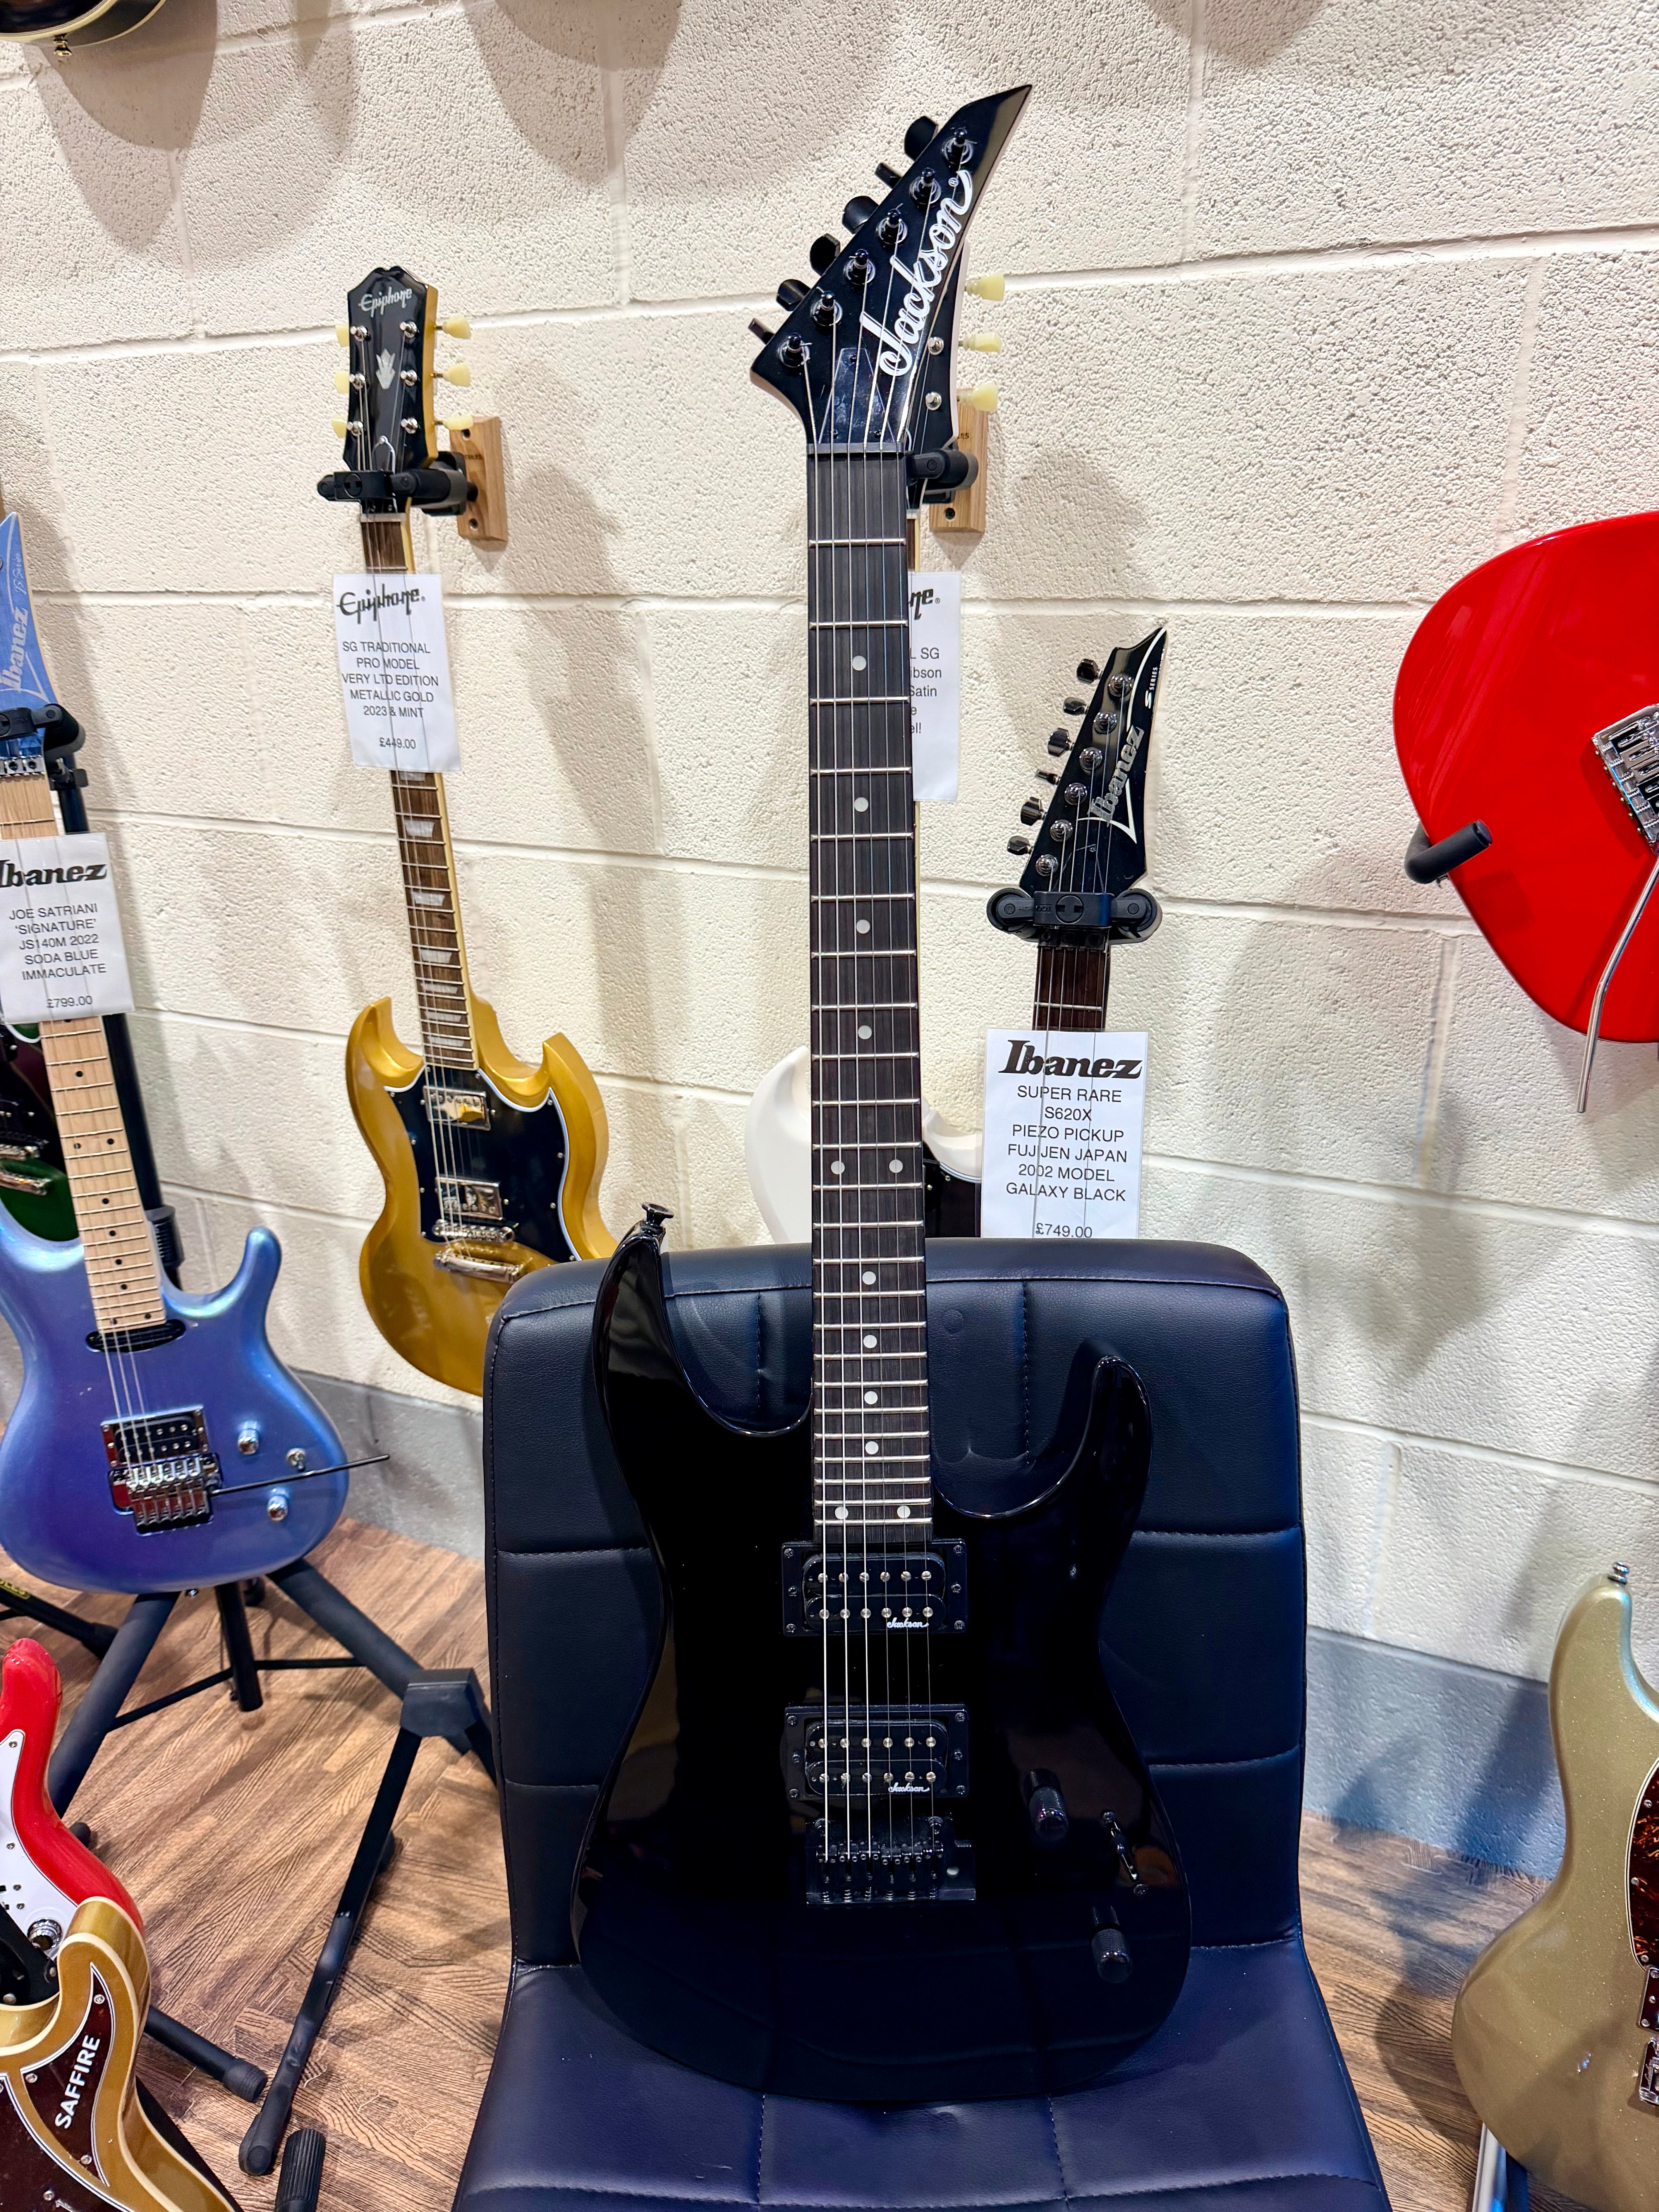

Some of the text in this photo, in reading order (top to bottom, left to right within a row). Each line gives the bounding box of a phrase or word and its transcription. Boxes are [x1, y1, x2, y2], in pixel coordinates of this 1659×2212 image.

[859, 169, 974, 377] Jackson
[359, 287, 412, 317] Epiphone
[337, 584, 420, 624] Epiphone
[0, 606, 28, 693] Ibanez
[343, 641, 431, 654] SG TRADITIONAL
[920, 647, 940, 659] SG
[357, 658, 419, 670] PRO MODEL
[910, 666, 941, 678] ibson
[342, 674, 439, 686] VERY LTD EDITION
[1149, 667, 1158, 690] SERIES
[350, 690, 434, 702] METALLIC GOLD
[364, 707, 424, 718] 2023 & MINT
[380, 738, 416, 749] £449.00
[1087, 725, 1145, 828] Ibanez
[0, 859, 107, 888] Ibanez
[9, 903, 98, 921] JOE SATRIANI
[20, 934, 99, 950] JS140M 2022
[25, 950, 99, 965] SODA BLUE
[22, 963, 106, 981] IMMACULATE
[47, 996, 93, 1008] £799.00
[998, 1039, 1143, 1079] Ibanez
[1017, 1085, 1122, 1103] SUPER RARE
[1044, 1106, 1092, 1121] S620X
[1013, 1125, 1124, 1142] PIEZO PICKUP
[1075, 1148, 1127, 1163] JAPAN
[1018, 1164, 1115, 1182] 2002 MODEL
[1006, 1183, 1126, 1201] GALAXY BLACK
[1035, 1223, 1092, 1238] £749.00
[886, 1617, 929, 1629] Jackson
[888, 1782, 930, 1793] Jackson
[55, 2034, 101, 2130] SAFFIRE
